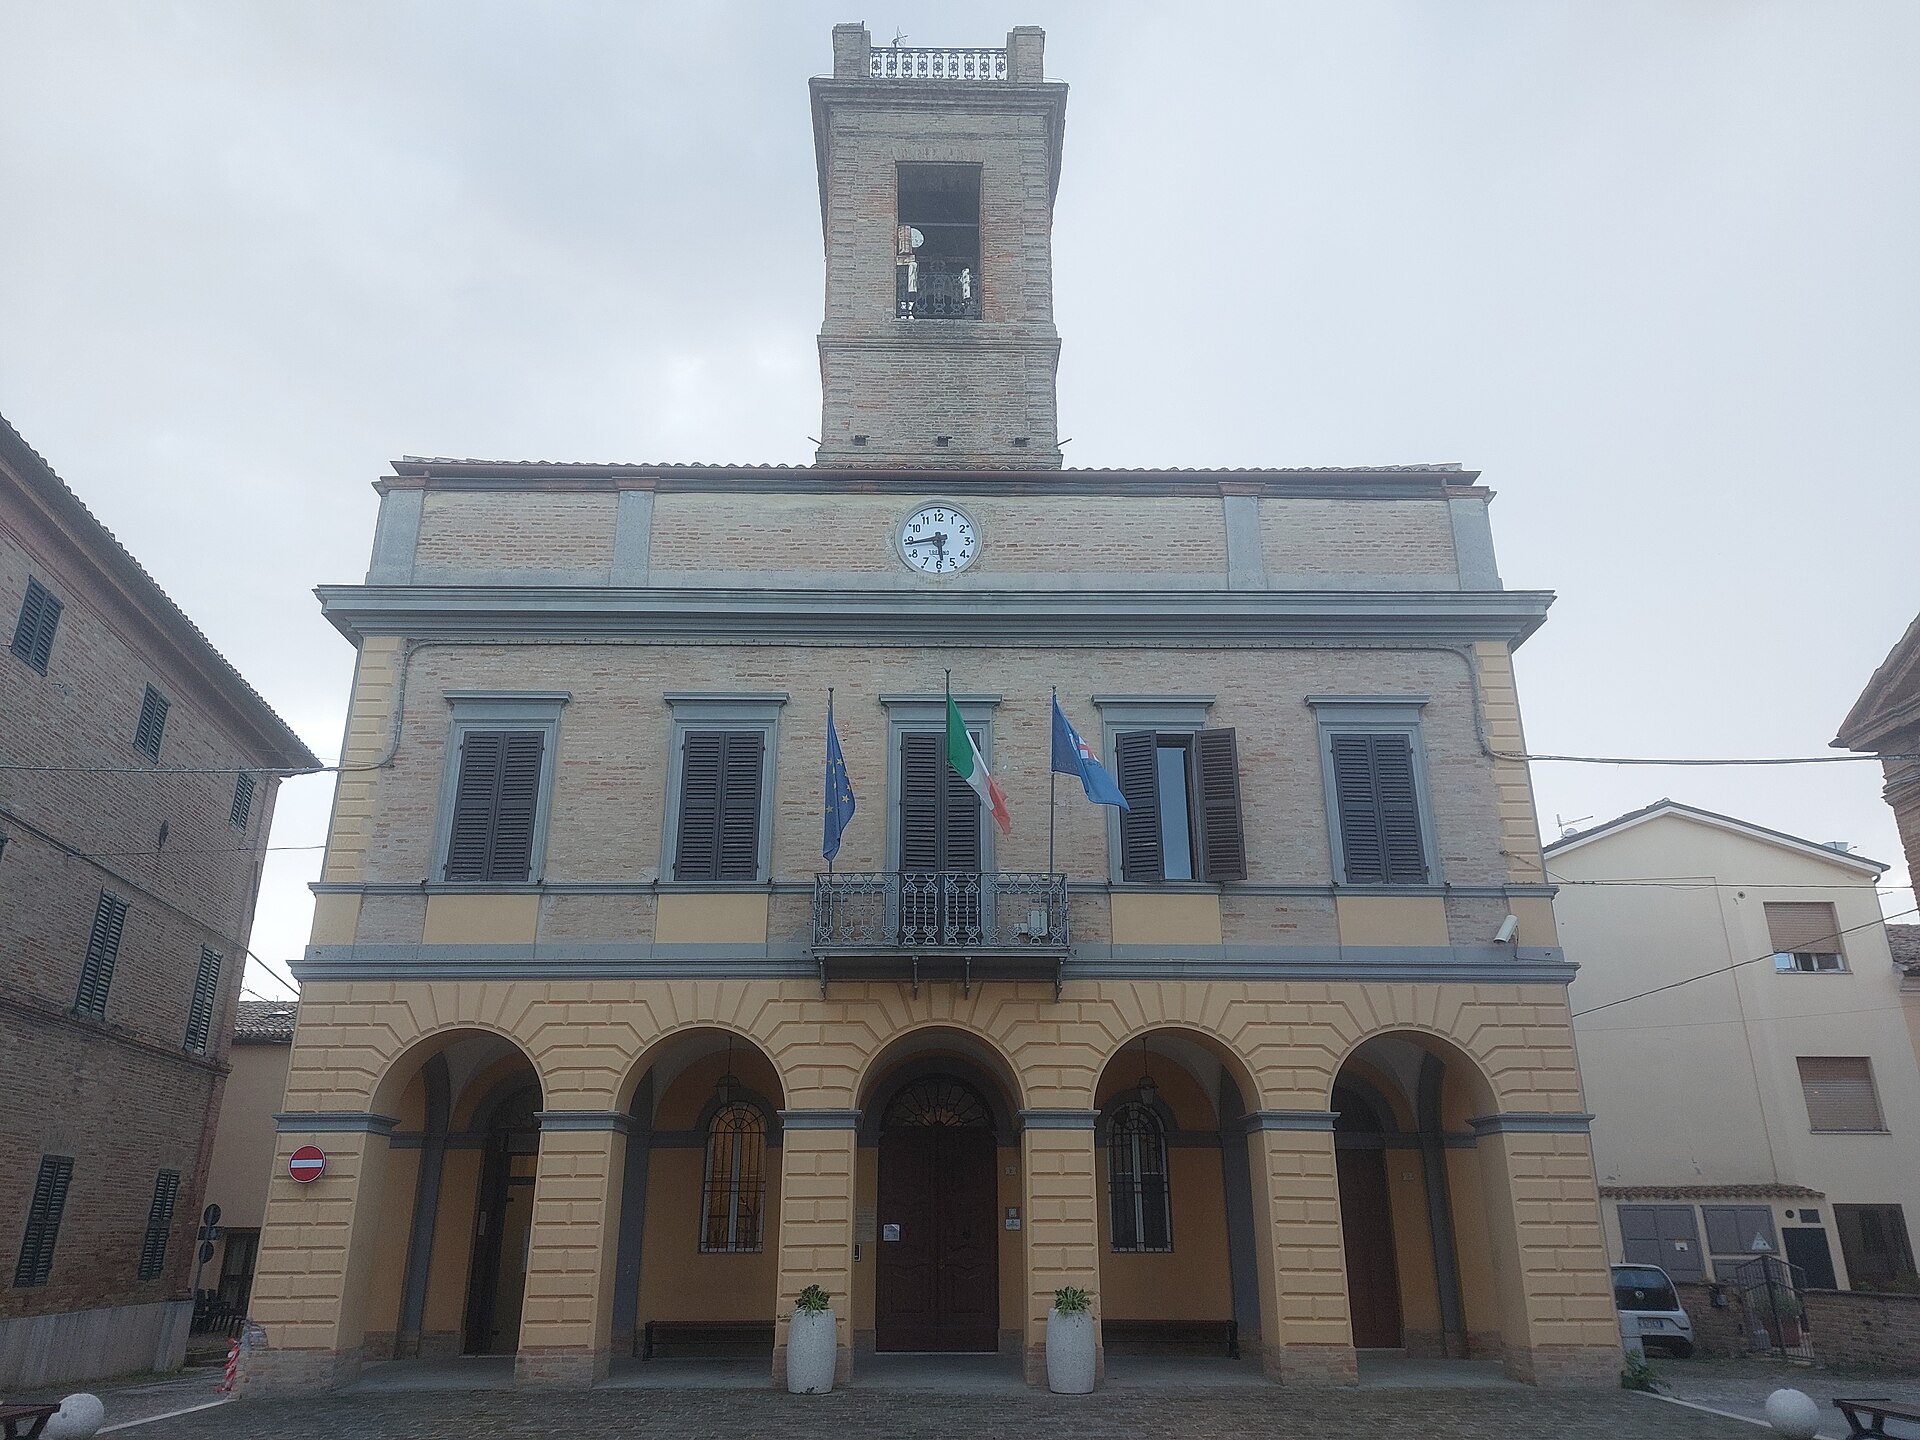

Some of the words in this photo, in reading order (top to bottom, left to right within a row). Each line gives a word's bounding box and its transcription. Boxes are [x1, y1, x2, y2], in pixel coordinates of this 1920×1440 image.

[922, 516, 929, 525] 11
[934, 513, 944, 522] 12
[950, 516, 954, 525] 1
[912, 524, 921, 533] 10
[959, 524, 966, 533] 2
[907, 536, 914, 545] 9
[964, 537, 971, 546] 3
[912, 549, 918, 558] 8
[960, 549, 966, 558] 4
[922, 557, 929, 566] 7
[935, 560, 942, 569] 6
[949, 558, 956, 567] 5
